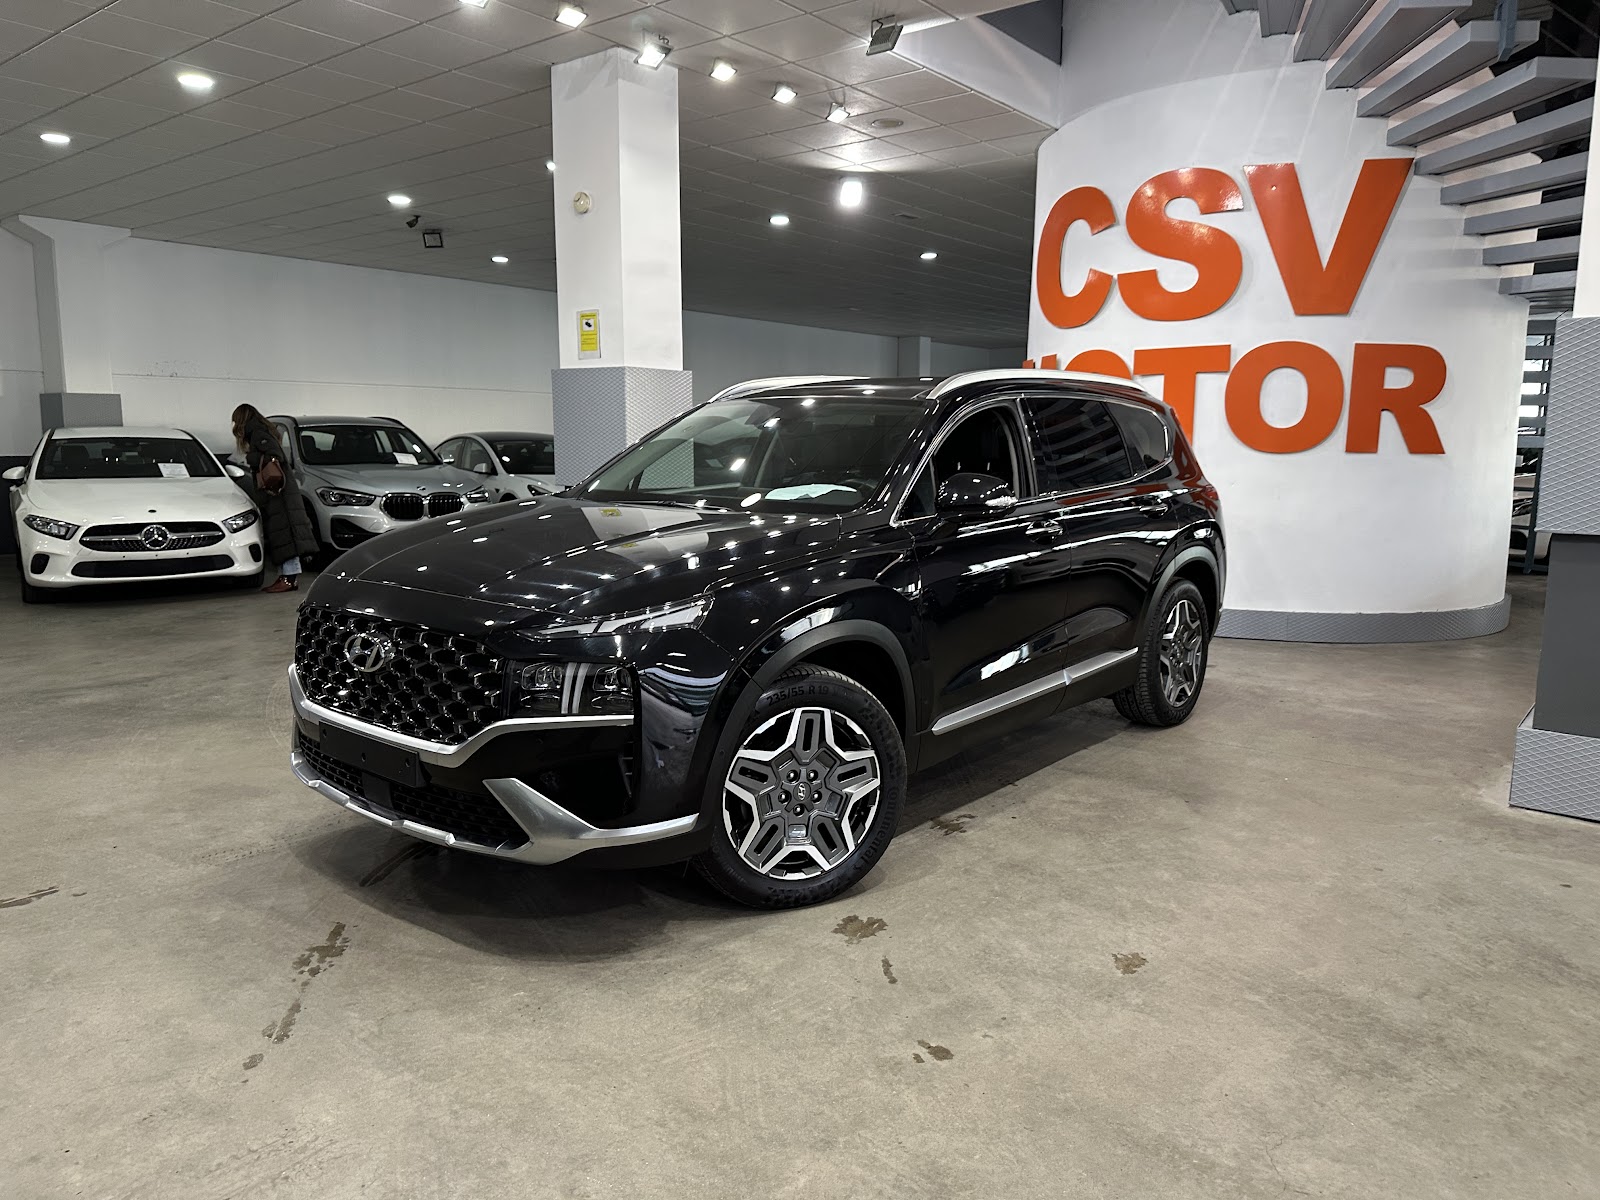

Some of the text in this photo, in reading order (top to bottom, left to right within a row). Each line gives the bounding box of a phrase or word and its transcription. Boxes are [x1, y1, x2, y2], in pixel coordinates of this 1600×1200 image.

[1037, 158, 1414, 328] CSV
[1022, 341, 1446, 455] TOR
[766, 685, 805, 707] 235/55
[808, 685, 816, 695] R
[817, 685, 829, 695] 19
